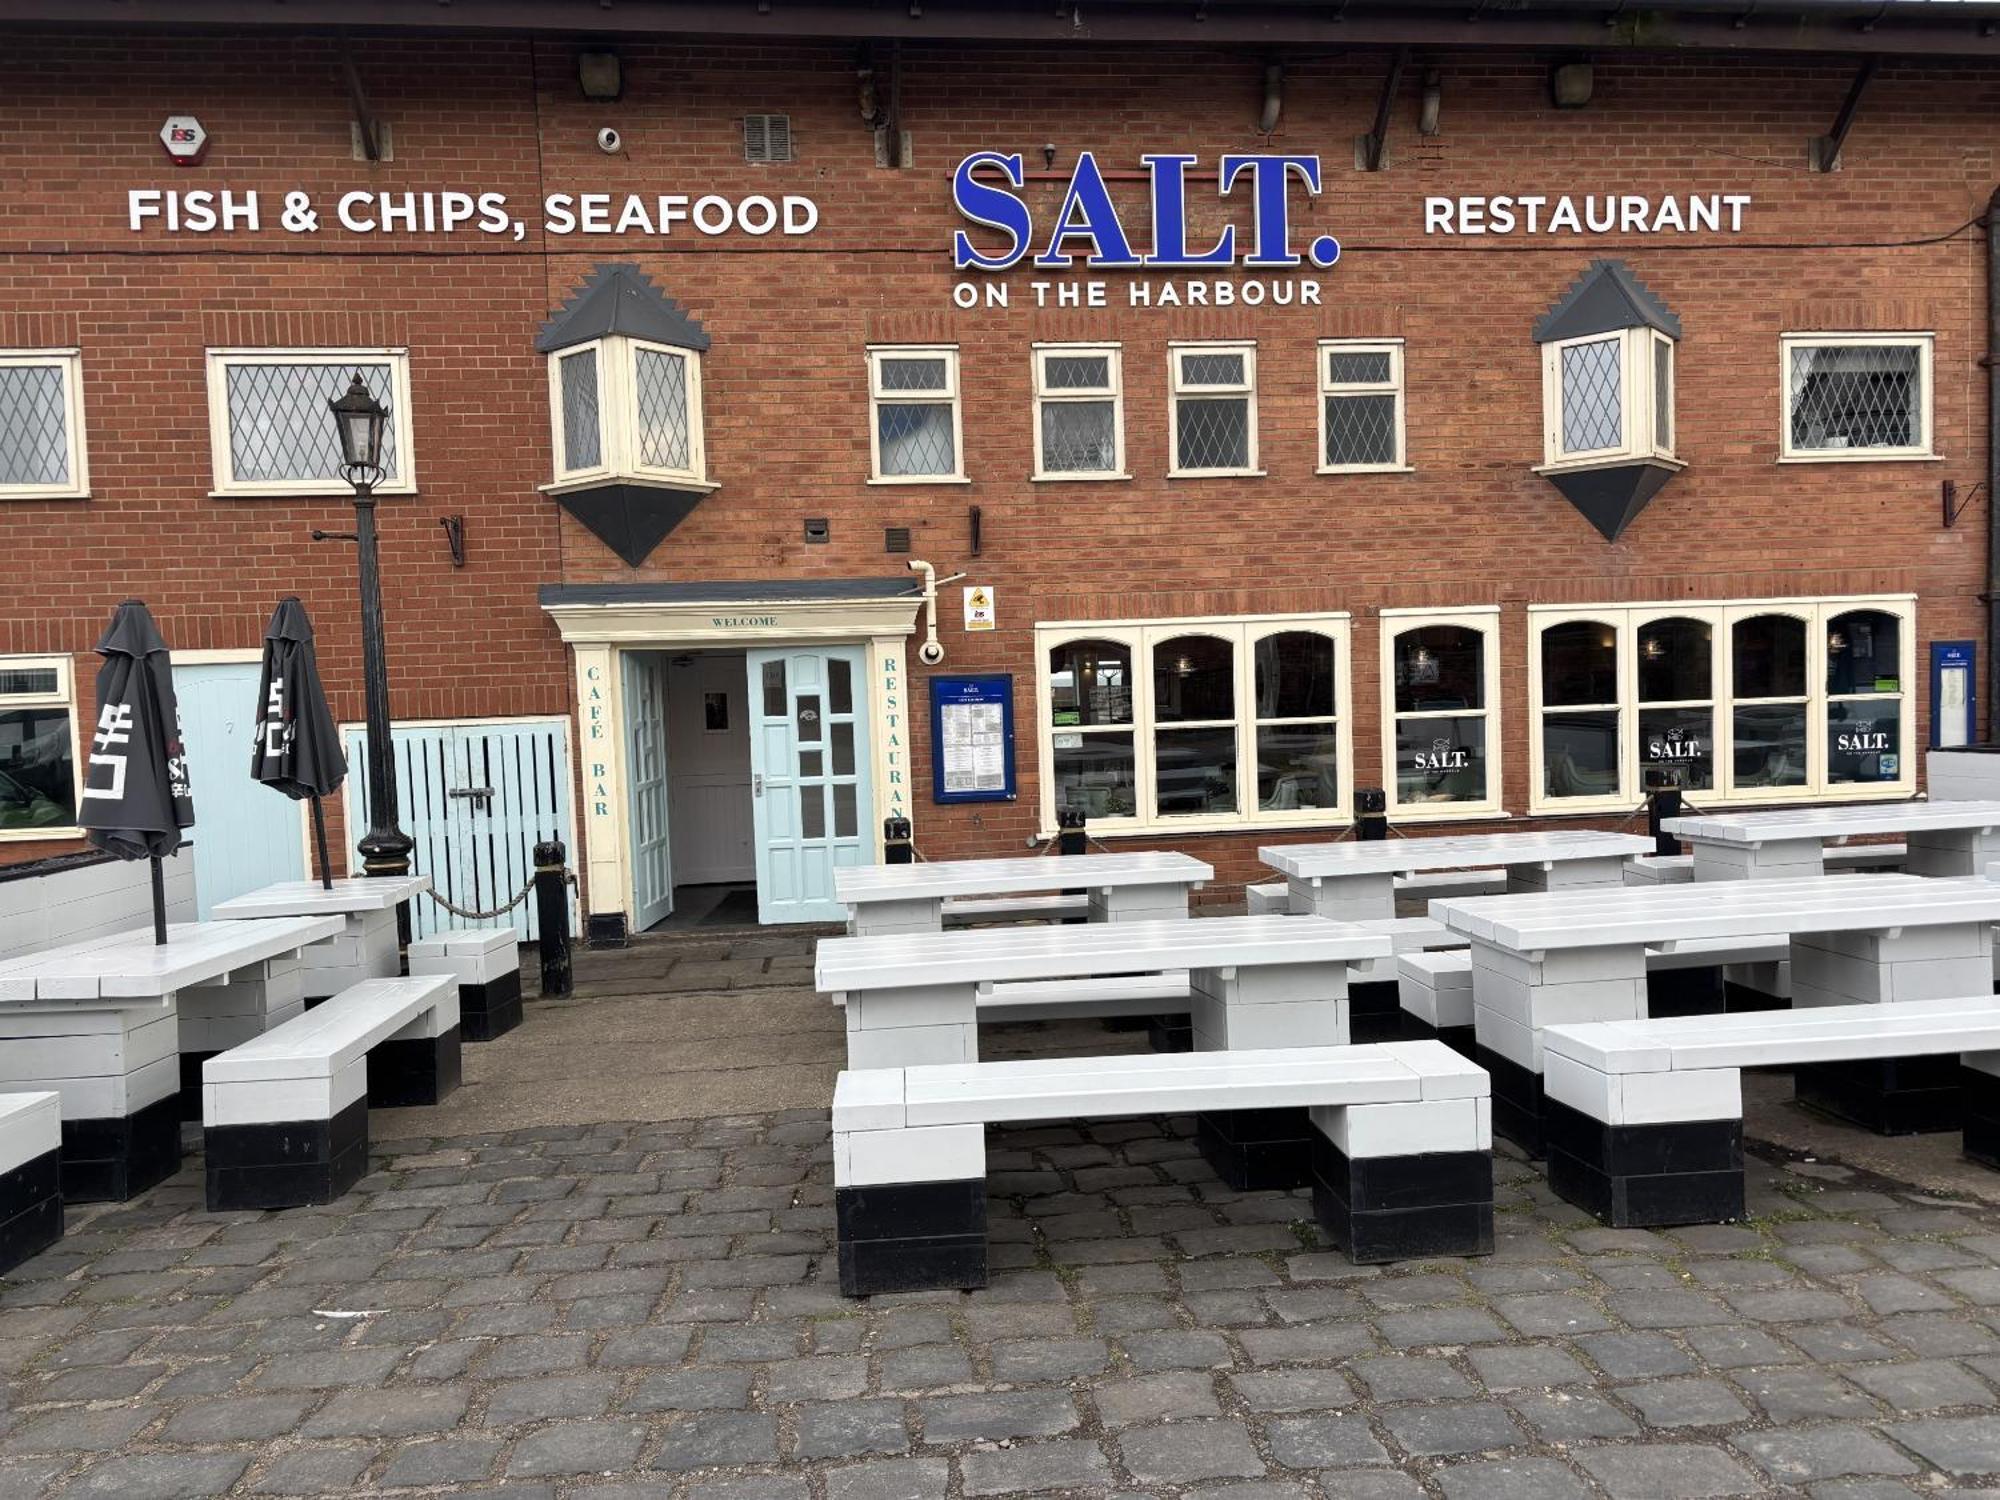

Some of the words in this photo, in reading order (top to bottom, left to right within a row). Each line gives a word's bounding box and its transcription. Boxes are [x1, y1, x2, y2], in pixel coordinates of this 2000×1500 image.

[128, 190, 259, 232] FISH
[281, 191, 319, 232] &
[337, 191, 525, 241] CHIPS,
[545, 193, 818, 235] SEAFOOD
[953, 150, 1341, 269] SALT.
[1425, 194, 1751, 234] RESTAURANT
[953, 282, 1008, 309] ON
[1031, 281, 1107, 308] THE
[1129, 279, 1323, 307] HARBOUR
[712, 617, 778, 626] WELCOME
[587, 666, 604, 738] CAFÉ
[884, 658, 903, 818] RESTAURAN
[1649, 740, 1702, 759] SALT.
[1835, 732, 1889, 750] SALT.
[1415, 751, 1469, 769] SALT.
[592, 763, 609, 815] BAR
